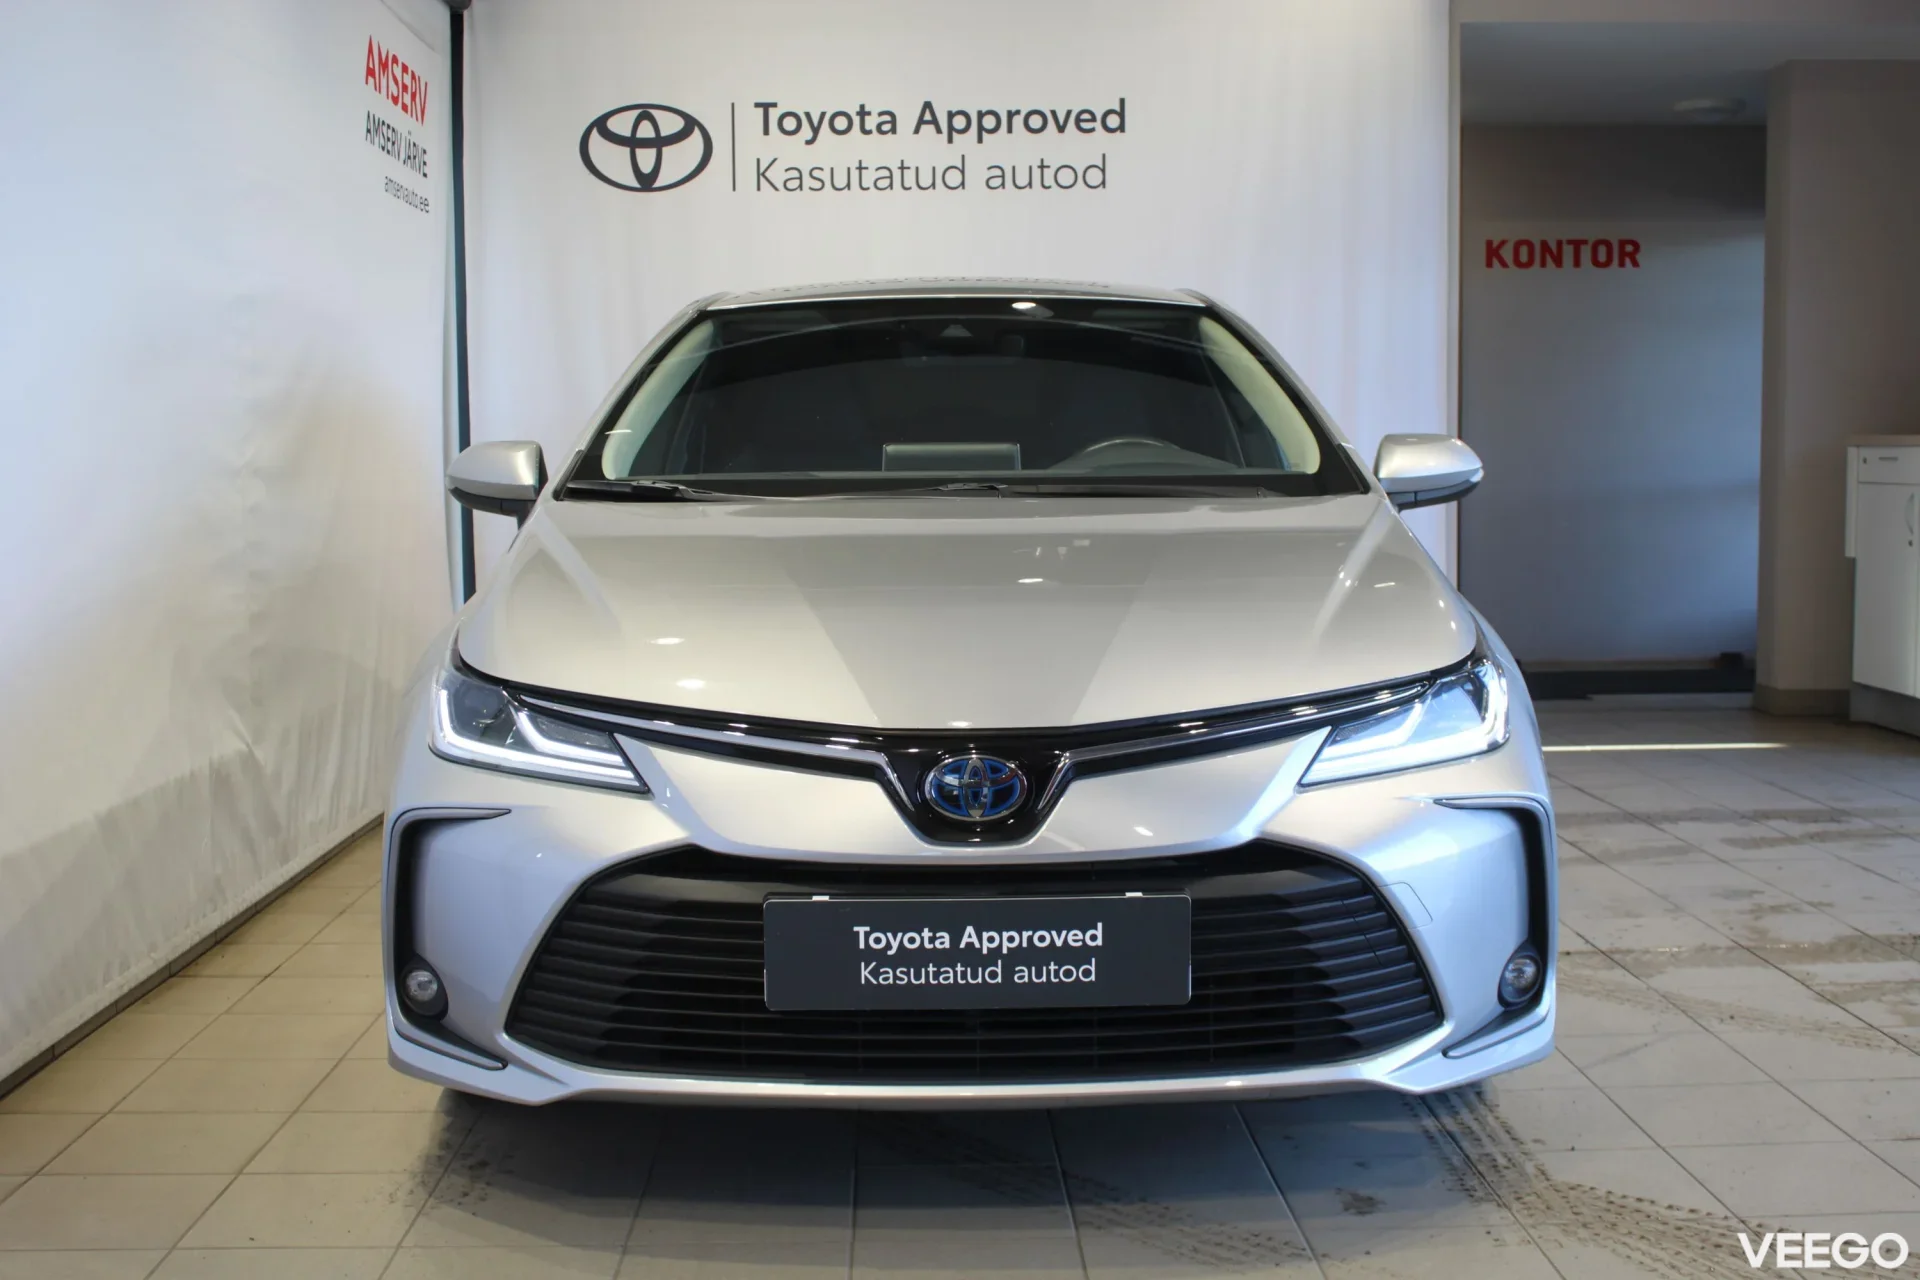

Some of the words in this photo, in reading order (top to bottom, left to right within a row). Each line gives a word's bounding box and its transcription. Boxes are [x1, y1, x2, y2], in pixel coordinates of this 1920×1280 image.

[365, 34, 428, 126] AMSERV
[754, 101, 898, 146] Toyota
[912, 98, 1127, 144] Approved
[365, 110, 402, 162] AMSERV
[403, 130, 428, 179] JÄRVE
[755, 153, 966, 193] Kasutatud
[984, 153, 1108, 191] autod
[384, 175, 430, 214] amservauto.ee
[1485, 238, 1642, 270] KONTOR
[853, 926, 951, 956] Toyota
[959, 922, 1104, 954] Approved
[859, 959, 1002, 986] Kasutatud
[1013, 957, 1096, 984] autod
